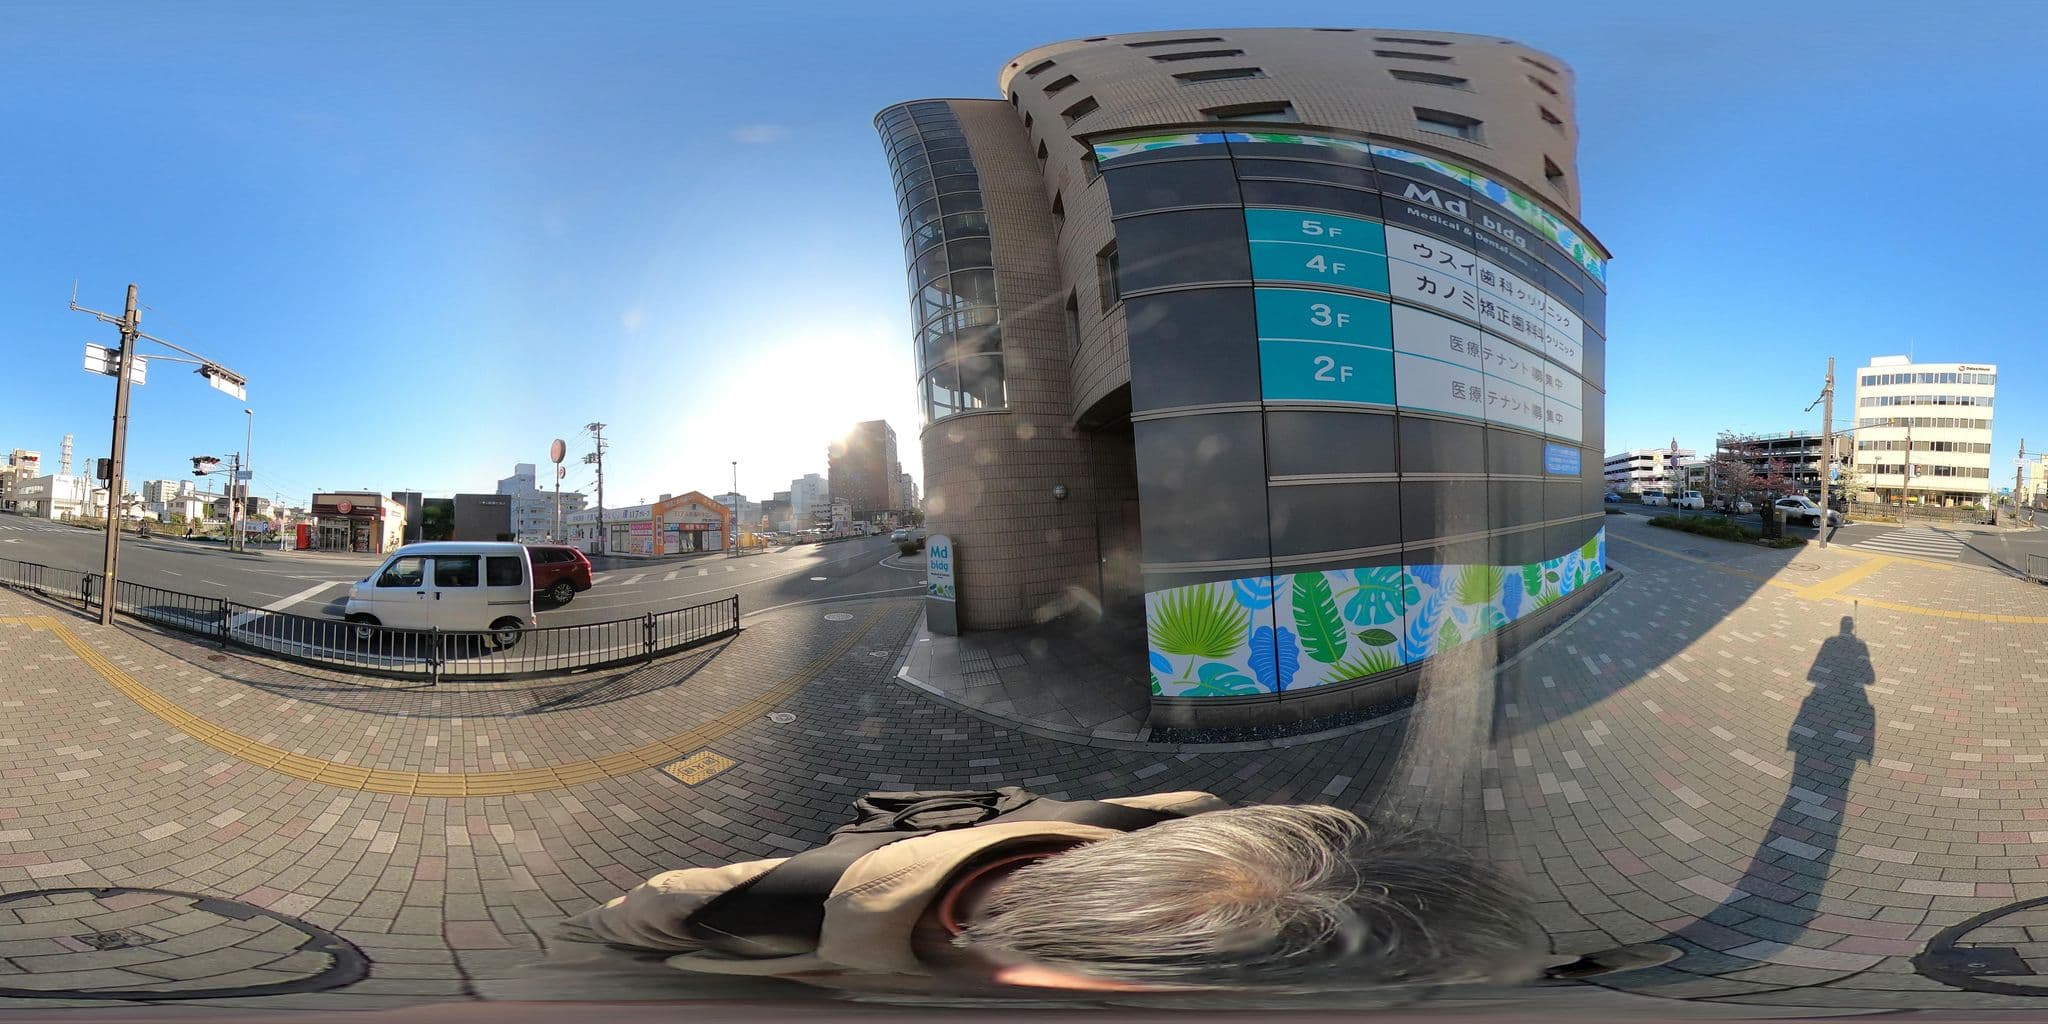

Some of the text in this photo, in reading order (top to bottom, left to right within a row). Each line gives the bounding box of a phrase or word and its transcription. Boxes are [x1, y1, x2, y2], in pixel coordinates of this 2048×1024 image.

[1403, 183, 1527, 249] Md bldg
[1302, 220, 1342, 238] 5F
[1407, 207, 1509, 255] Medical & Dental
[1306, 255, 1346, 274] 4F
[1310, 303, 1350, 328] 3F
[1313, 355, 1353, 383] 2F
[930, 544, 948, 559] Md
[930, 560, 949, 572] bldg
